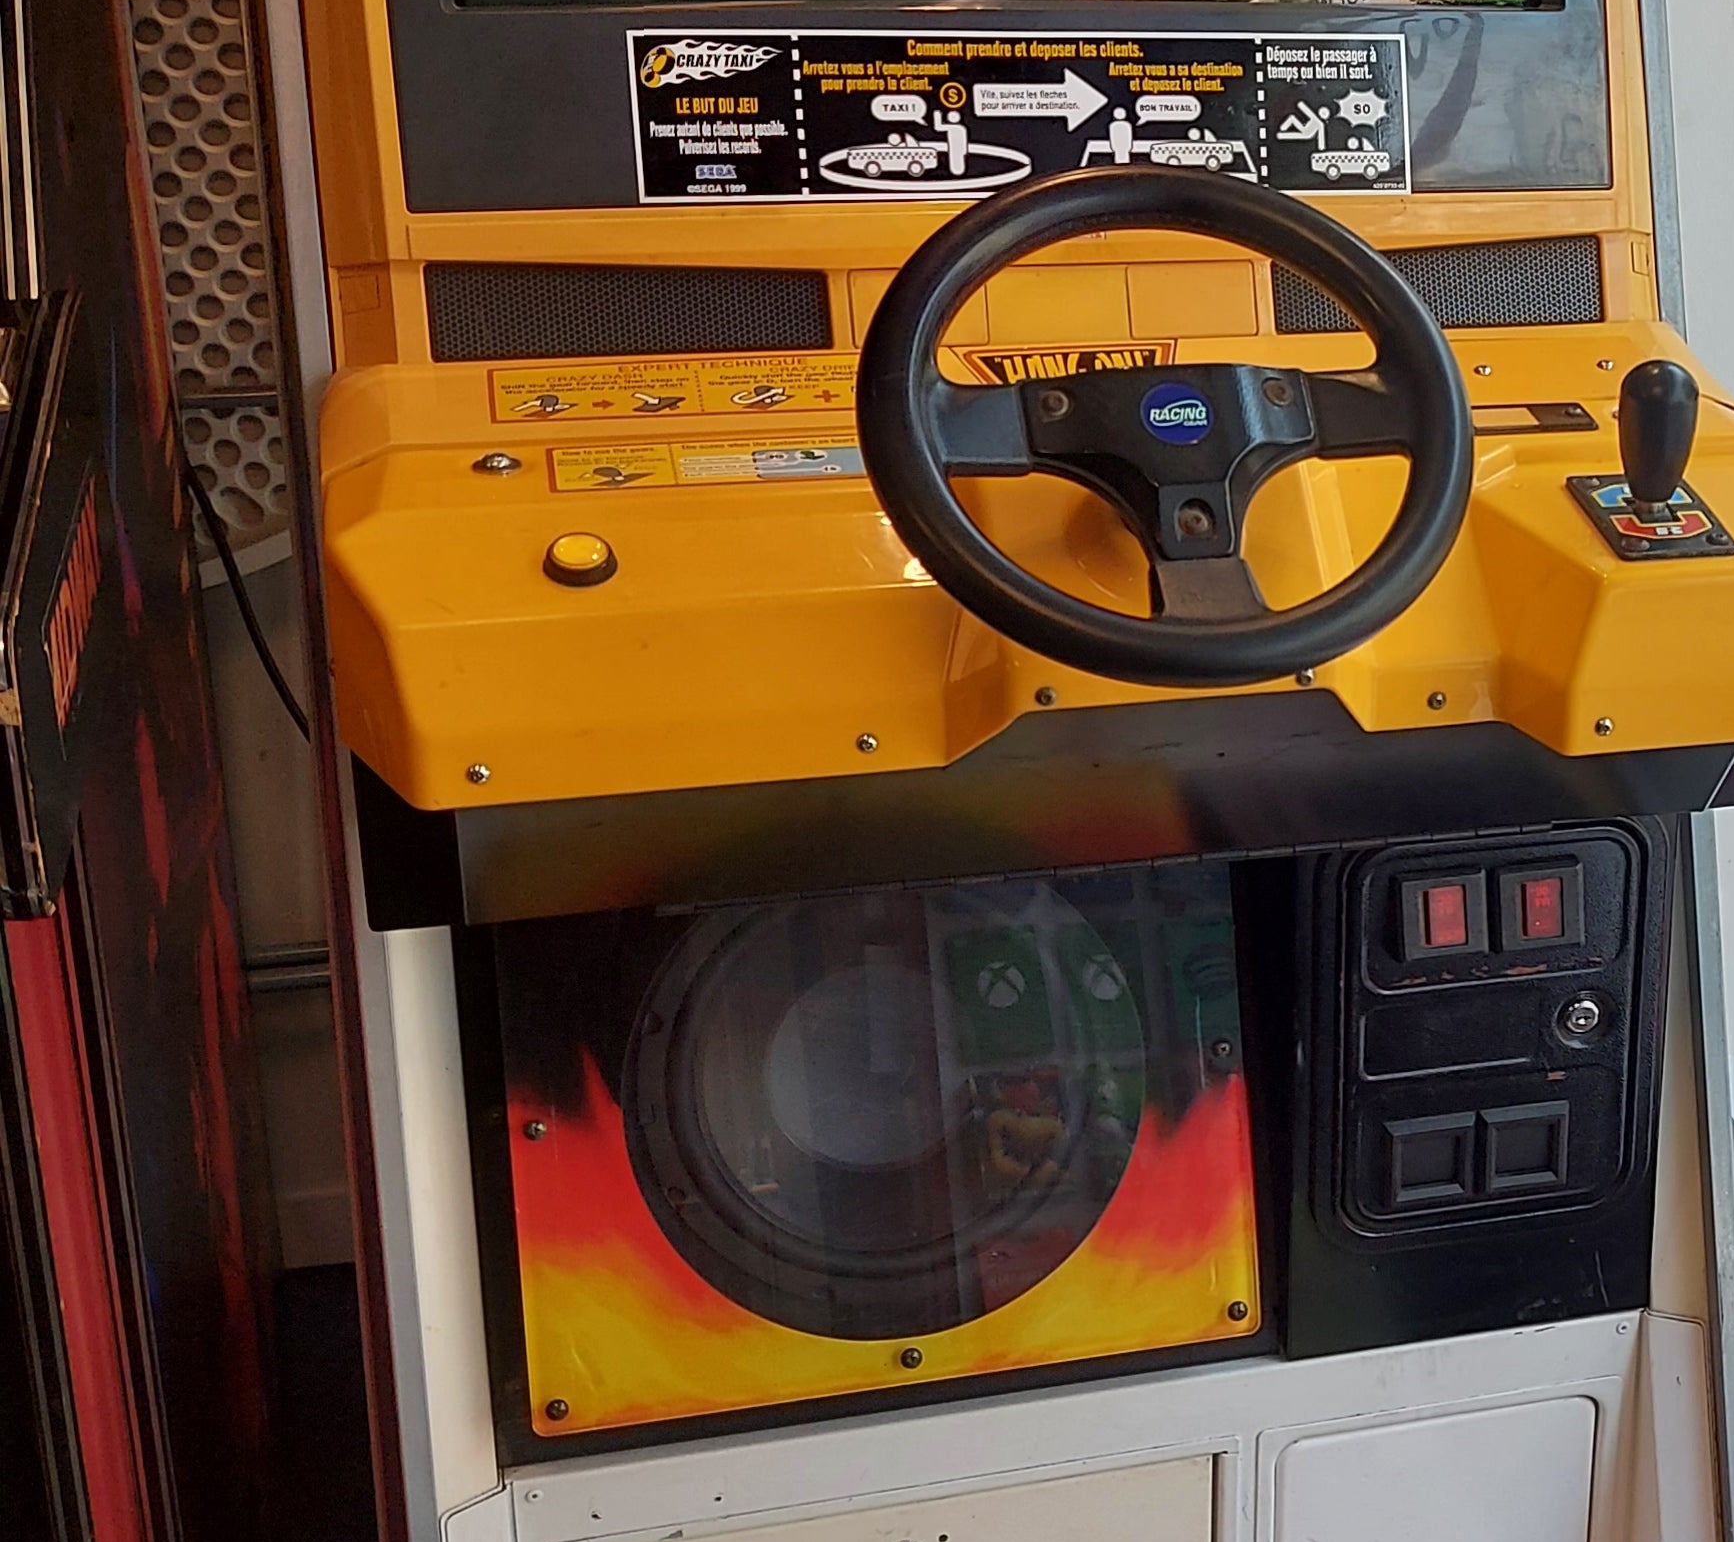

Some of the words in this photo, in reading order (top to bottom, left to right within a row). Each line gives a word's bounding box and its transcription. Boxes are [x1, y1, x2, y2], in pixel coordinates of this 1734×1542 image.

[907, 39, 963, 57] Comment
[966, 41, 1011, 60] prendre
[1015, 42, 1027, 57] et
[1080, 41, 1097, 57] les
[1100, 41, 1144, 58] clients.
[1266, 45, 1309, 65] Déposez
[1311, 45, 1320, 62] le
[1322, 48, 1368, 66] passager
[677, 53, 722, 67] CRAZY
[723, 53, 754, 67] TAXI
[841, 62, 864, 76] vous
[1145, 64, 1167, 76] vous
[1191, 62, 1244, 77] destination
[1268, 64, 1298, 82] temps
[1301, 66, 1313, 80] ou
[1316, 63, 1338, 80] bien
[1339, 63, 1347, 80] il
[821, 78, 843, 93] pour
[846, 76, 884, 94] prendre
[676, 97, 690, 115] LE
[692, 97, 715, 114] BUT
[718, 97, 734, 114] DU
[737, 97, 758, 114] JEU
[882, 103, 910, 113] TAXI
[695, 164, 737, 180] SEGA
[617, 362, 690, 374] EXPERT
[701, 357, 809, 370] TECHNIQUE
[822, 363, 857, 372] DRIF
[1150, 404, 1207, 422] RACING
[1183, 418, 1208, 428] GEAR
